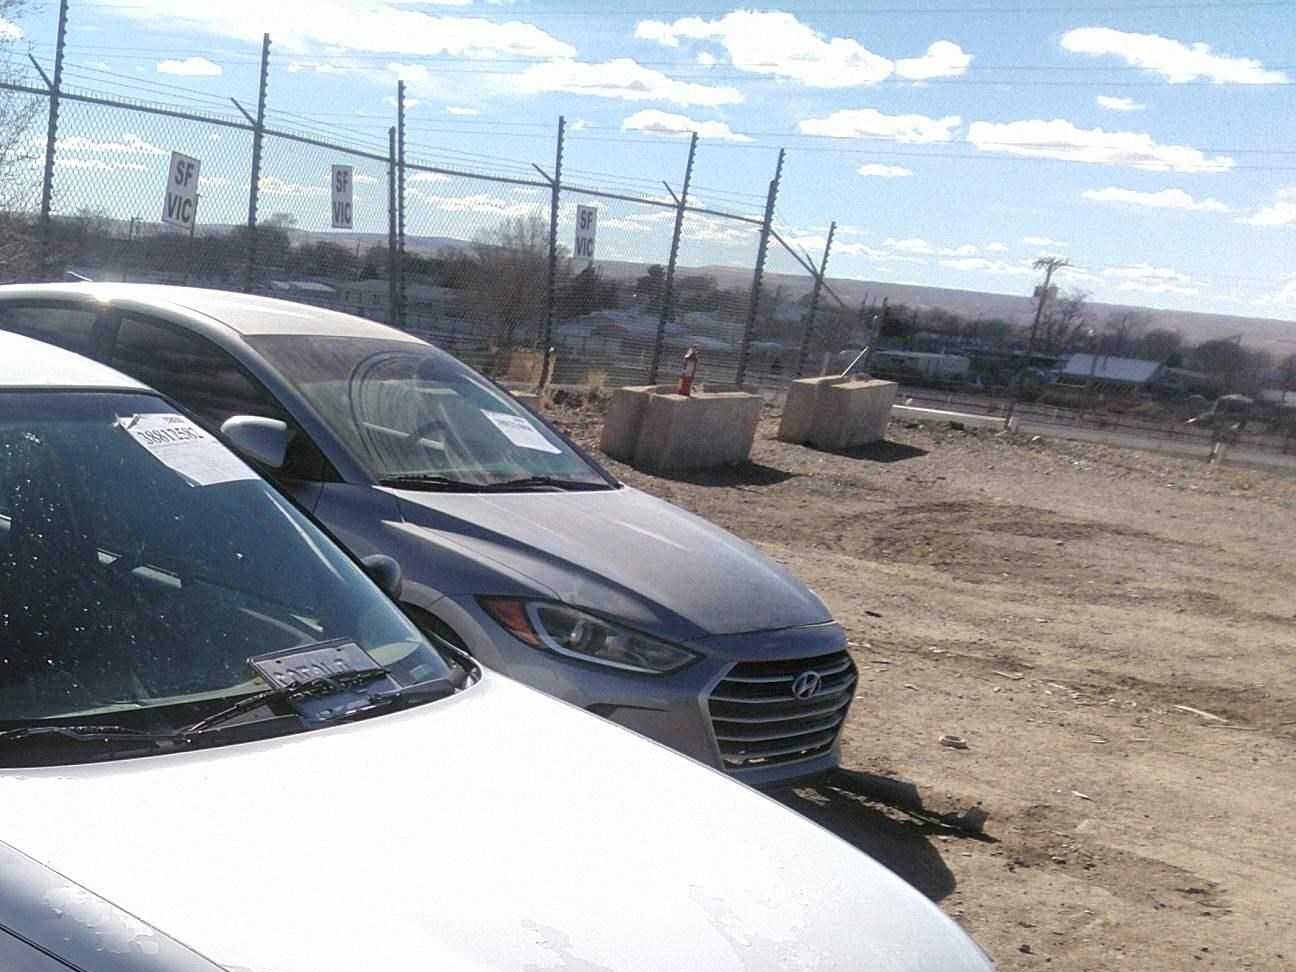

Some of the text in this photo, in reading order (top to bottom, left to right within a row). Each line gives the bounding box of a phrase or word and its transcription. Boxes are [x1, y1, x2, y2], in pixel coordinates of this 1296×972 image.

[174, 159, 194, 187] SF
[336, 170, 349, 192] SF
[168, 191, 193, 223] VIC
[334, 201, 352, 224] VIC
[580, 210, 594, 230] SF
[577, 237, 594, 257] VIC
